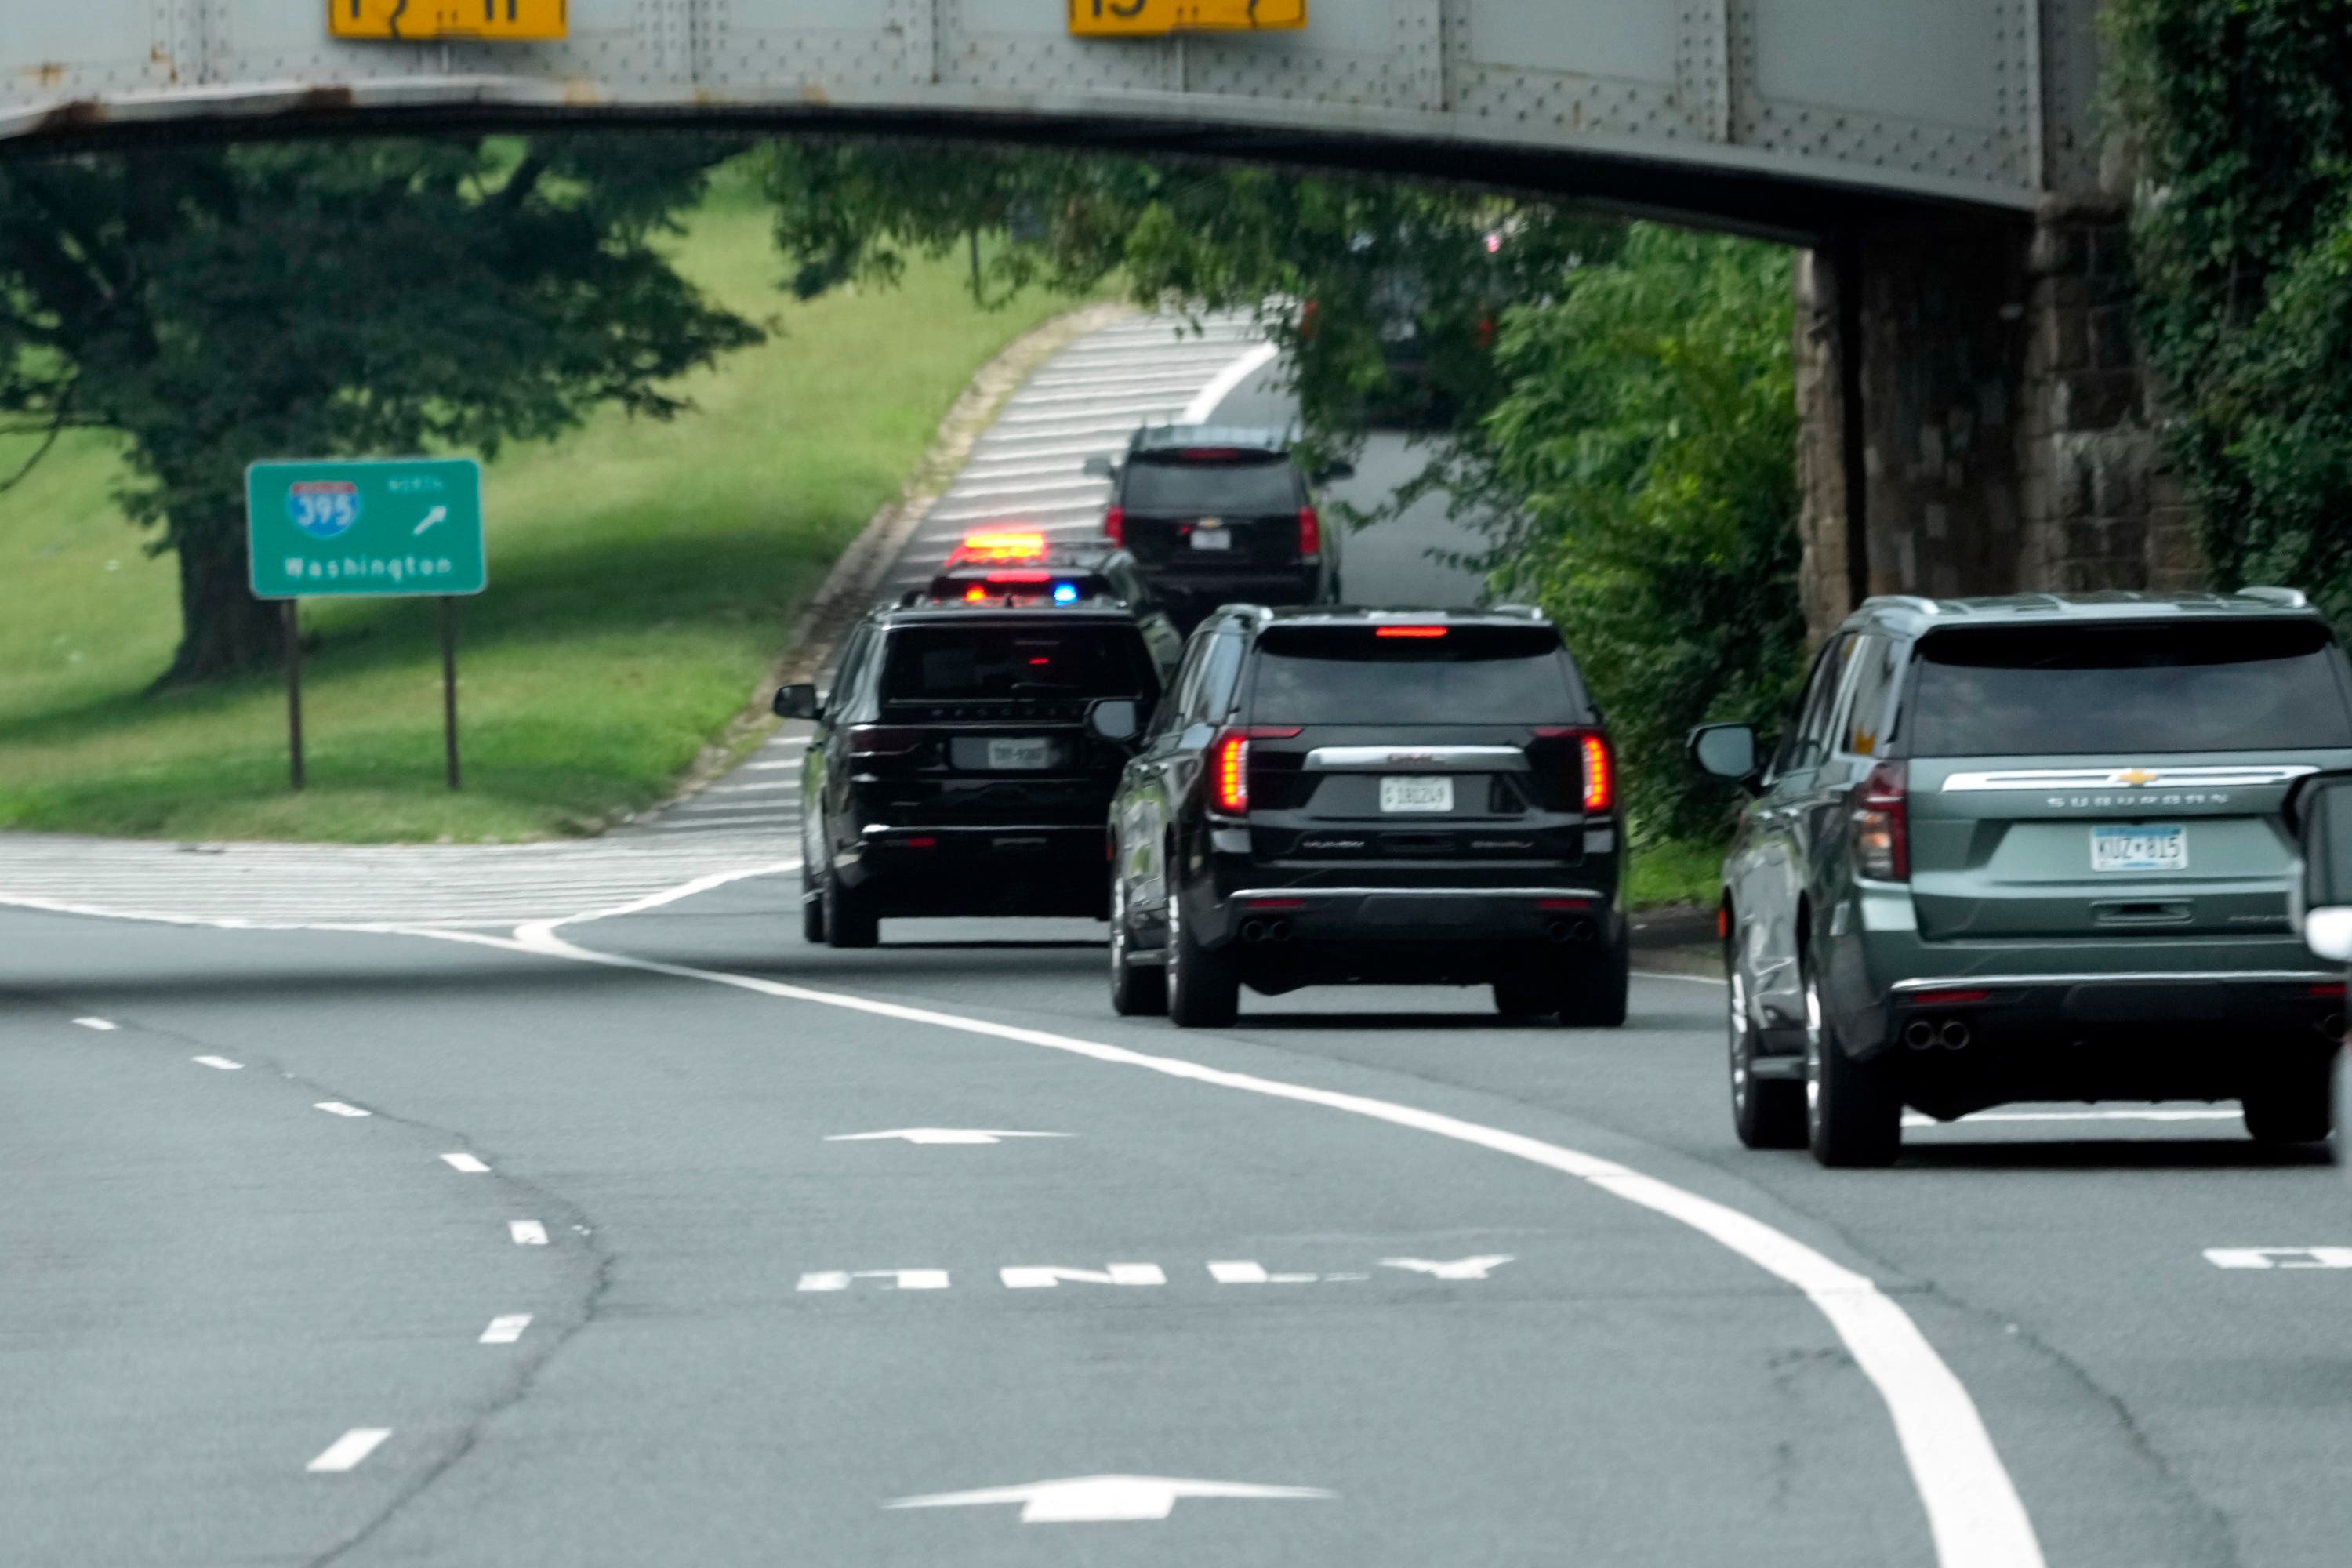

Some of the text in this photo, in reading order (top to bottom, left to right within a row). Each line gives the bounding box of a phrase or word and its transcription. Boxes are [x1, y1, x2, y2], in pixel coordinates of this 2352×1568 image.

[297, 493, 353, 527] 395
[285, 556, 452, 583] Washington
[795, 1254, 1517, 1292] ONLY
